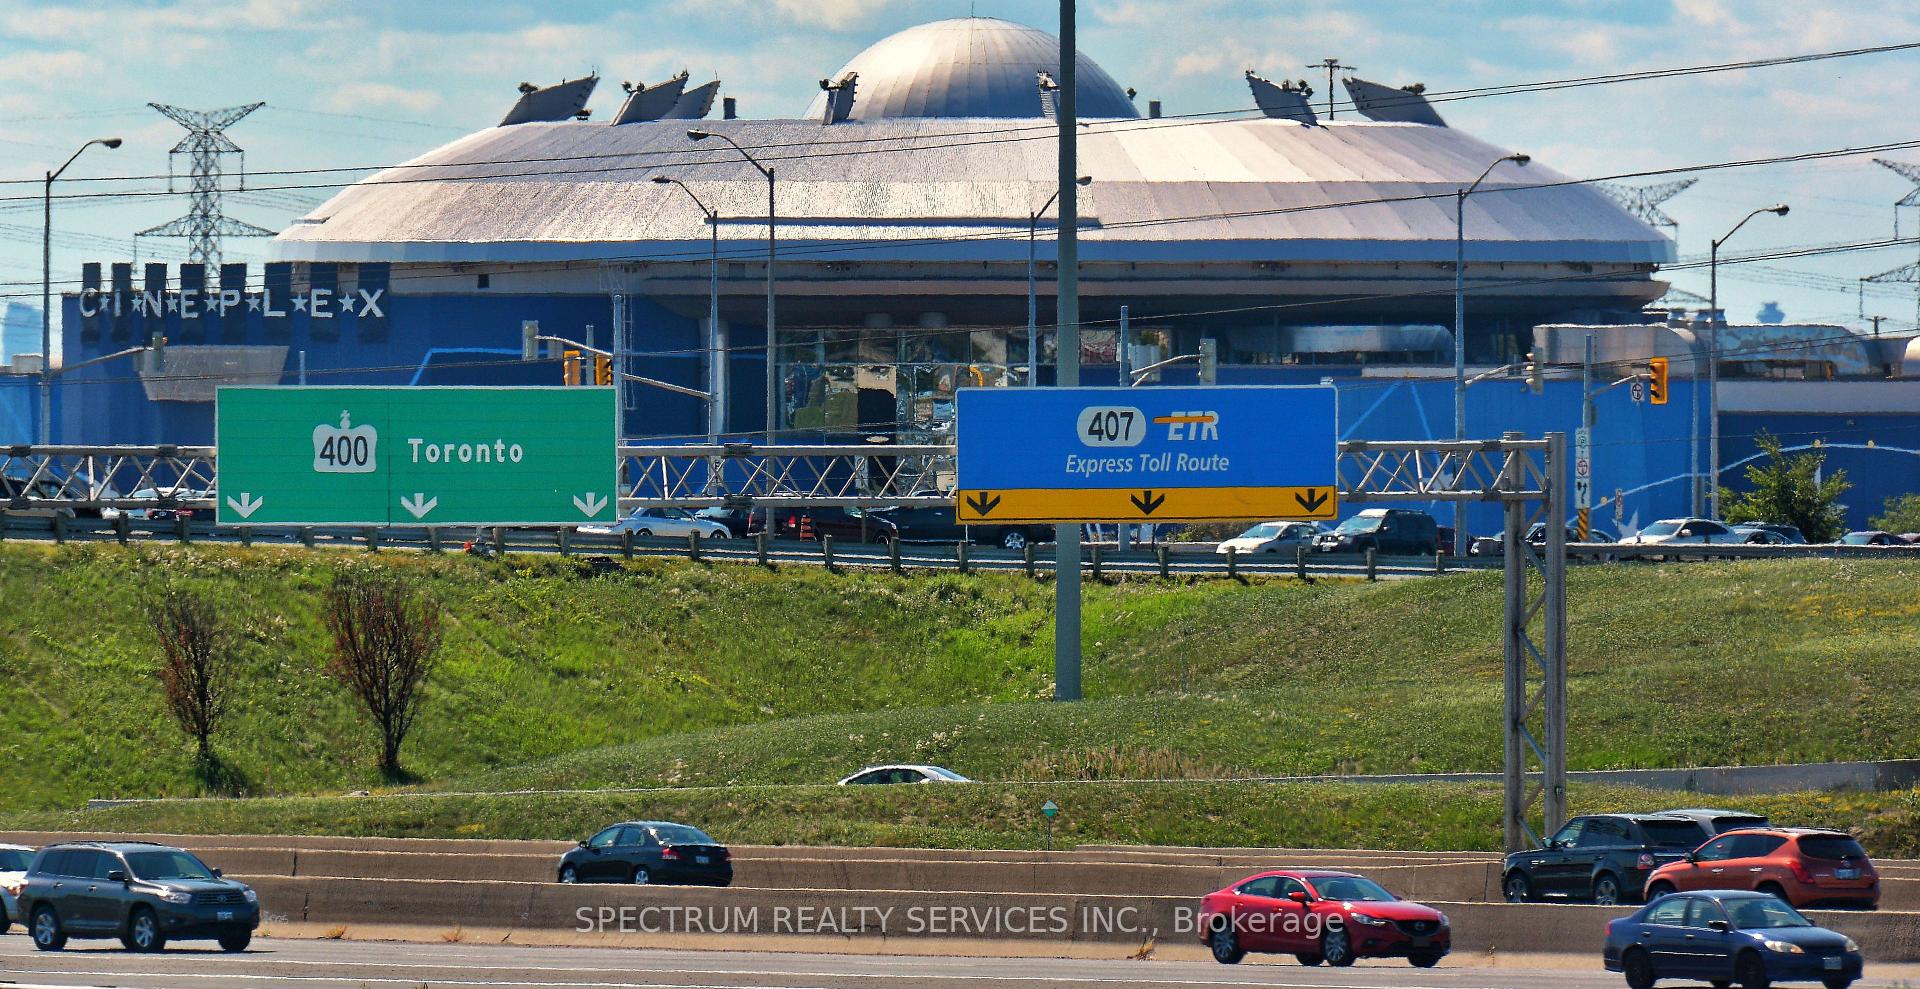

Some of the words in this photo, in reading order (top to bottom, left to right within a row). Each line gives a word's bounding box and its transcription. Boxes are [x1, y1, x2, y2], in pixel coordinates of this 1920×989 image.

[79, 288, 385, 319] CINEPLEX
[1087, 410, 1134, 442] 407
[1167, 410, 1220, 441] ETR
[319, 435, 369, 466] 400
[407, 438, 523, 463] Toronto
[1065, 454, 1133, 478] Express
[1139, 453, 1171, 472] Toll
[1176, 453, 1230, 472] Route
